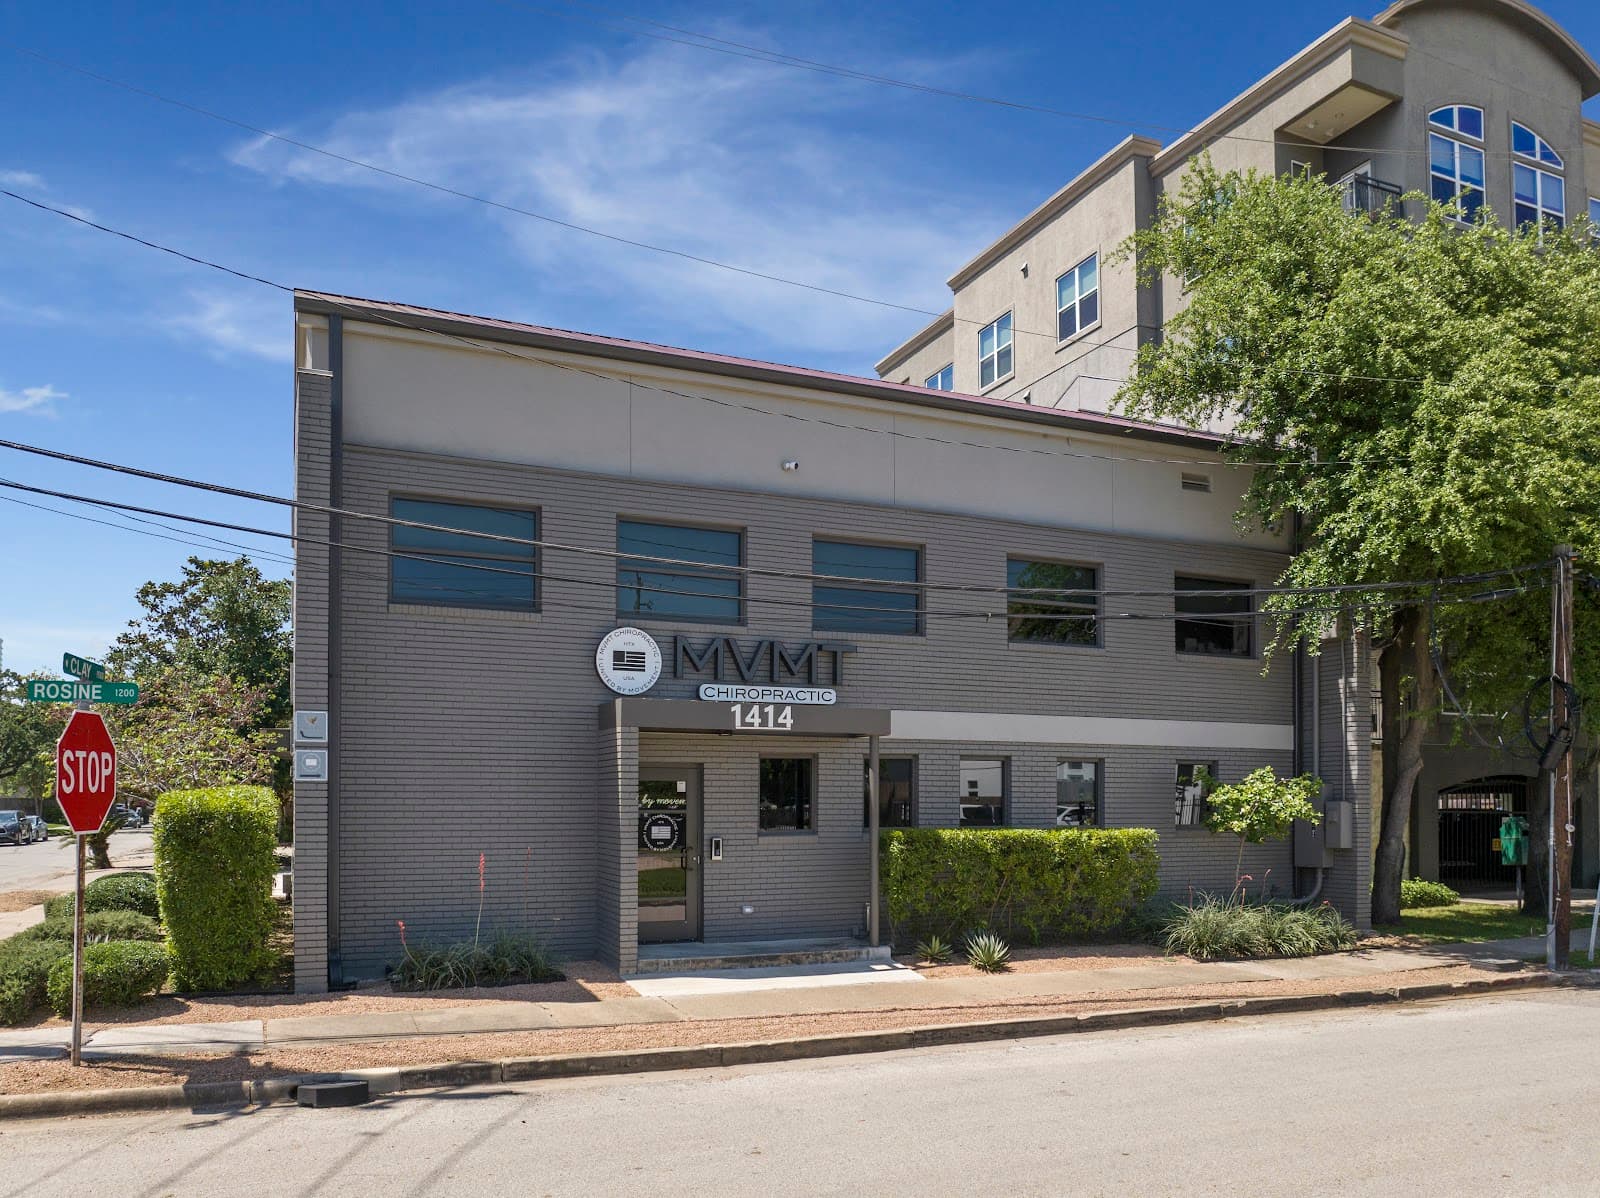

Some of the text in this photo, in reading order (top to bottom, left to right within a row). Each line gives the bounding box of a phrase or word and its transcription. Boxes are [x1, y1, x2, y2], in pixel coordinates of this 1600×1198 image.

[70, 657, 92, 680] CLAY
[673, 634, 857, 687] MVMT
[33, 683, 135, 700] ROSINE 1200
[703, 686, 833, 702] CHIROPRACTIC
[730, 703, 794, 728] 1414
[62, 750, 113, 794] STOP
